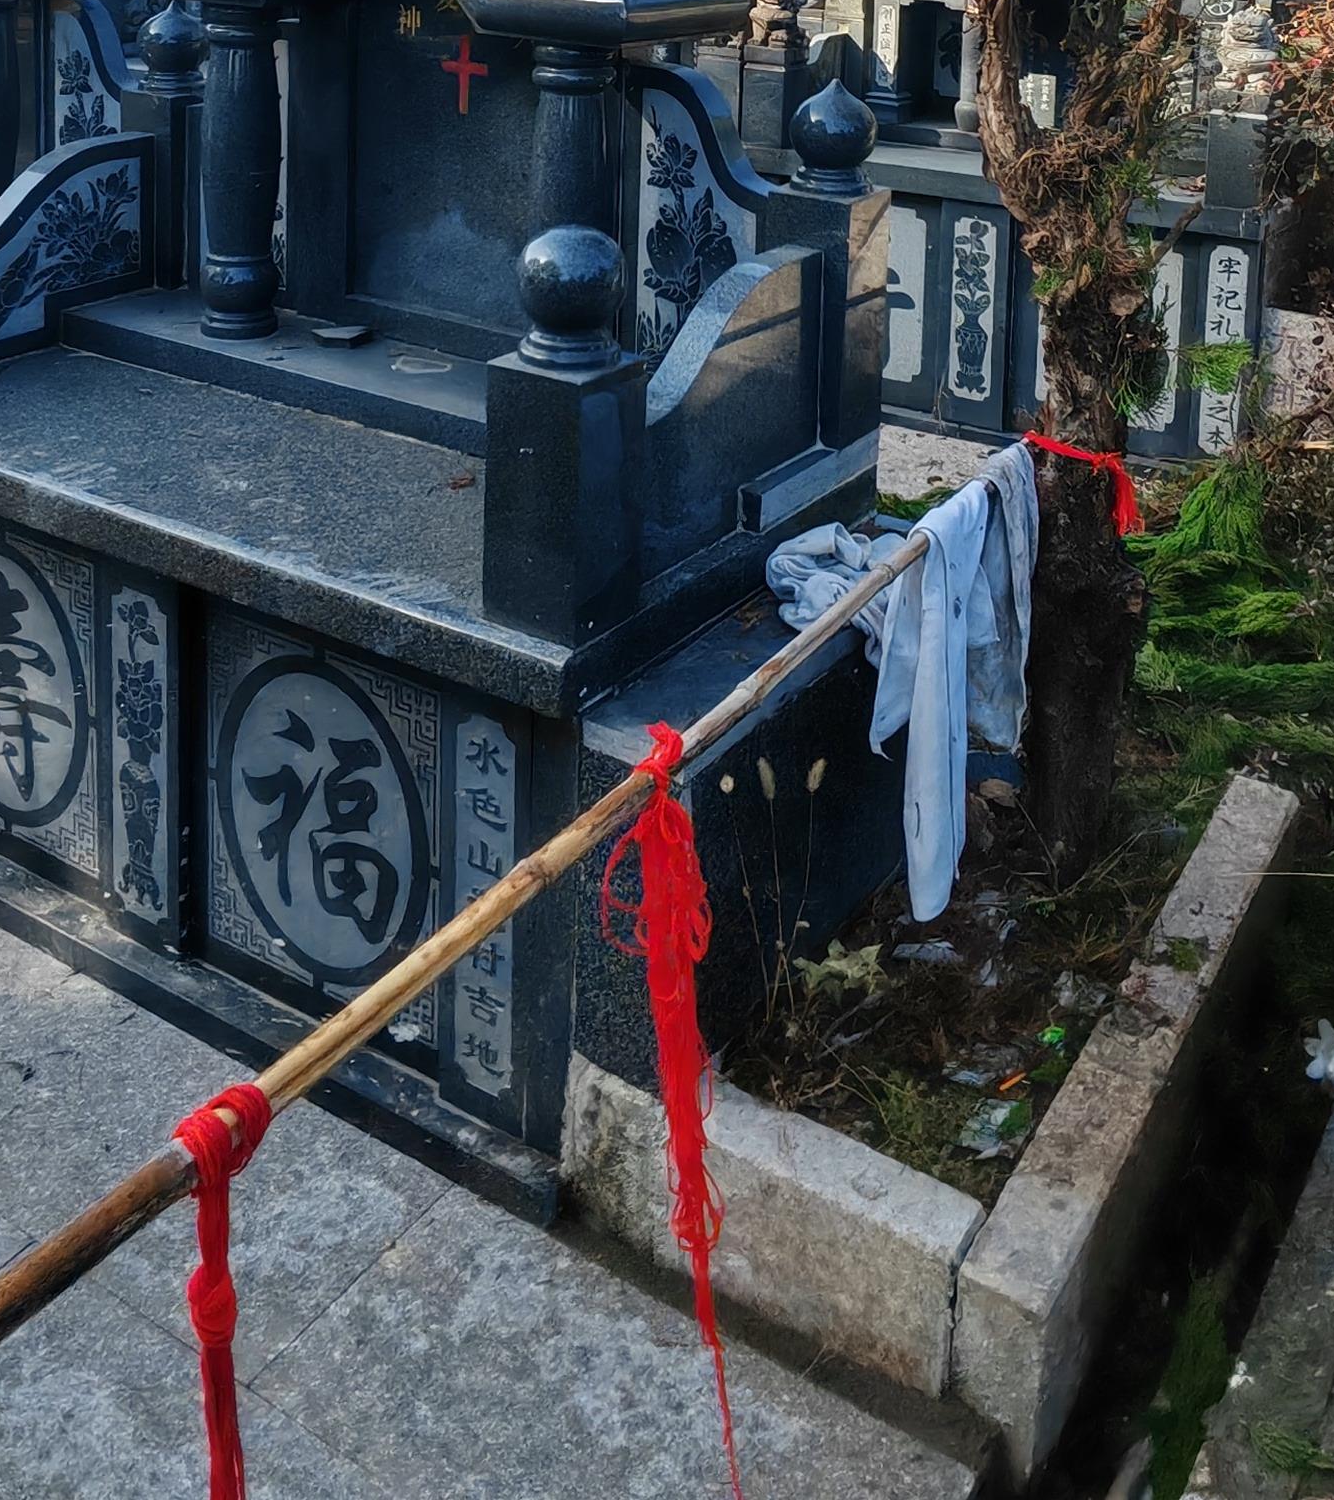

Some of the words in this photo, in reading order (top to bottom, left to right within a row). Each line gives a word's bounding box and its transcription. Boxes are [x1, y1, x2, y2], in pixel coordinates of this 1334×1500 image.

[1205, 256, 1243, 450] 牢记礼之本
[241, 708, 399, 946] 福
